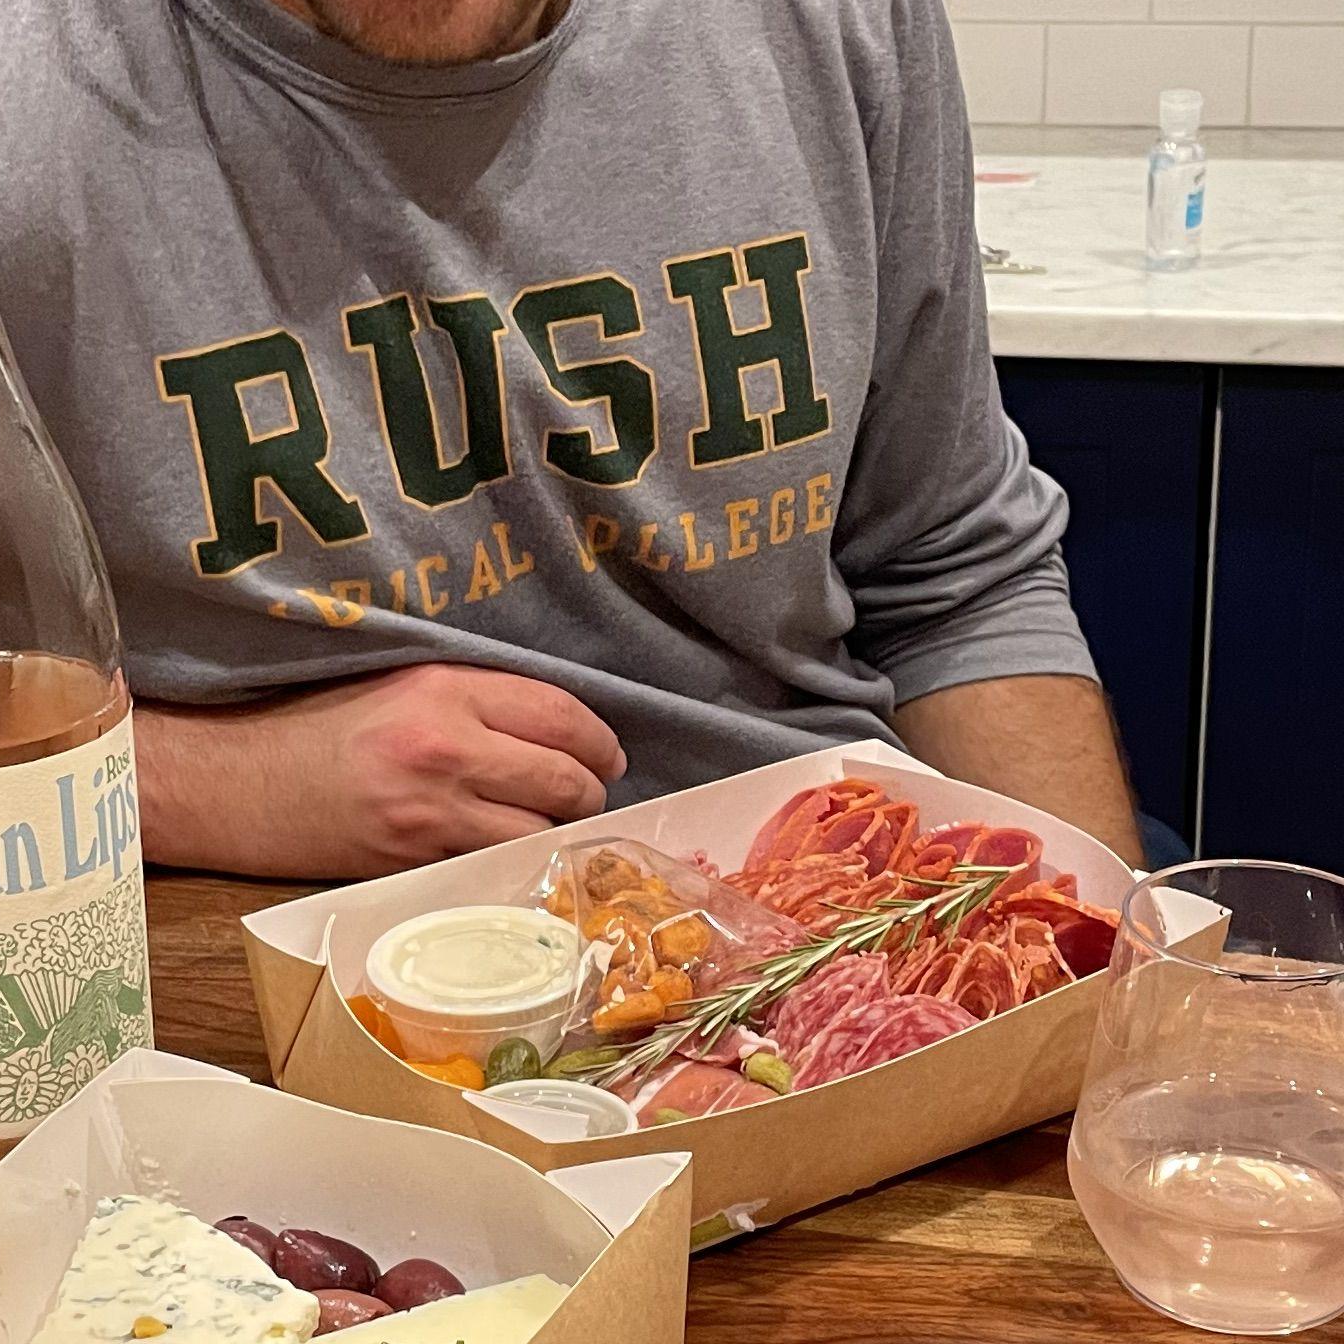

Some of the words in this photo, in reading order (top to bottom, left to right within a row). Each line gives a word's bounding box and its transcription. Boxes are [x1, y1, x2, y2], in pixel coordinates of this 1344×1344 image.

[155, 231, 833, 578] RUSH
[565, 472, 833, 573] OLLEGE
[56, 766, 137, 883] Lips
